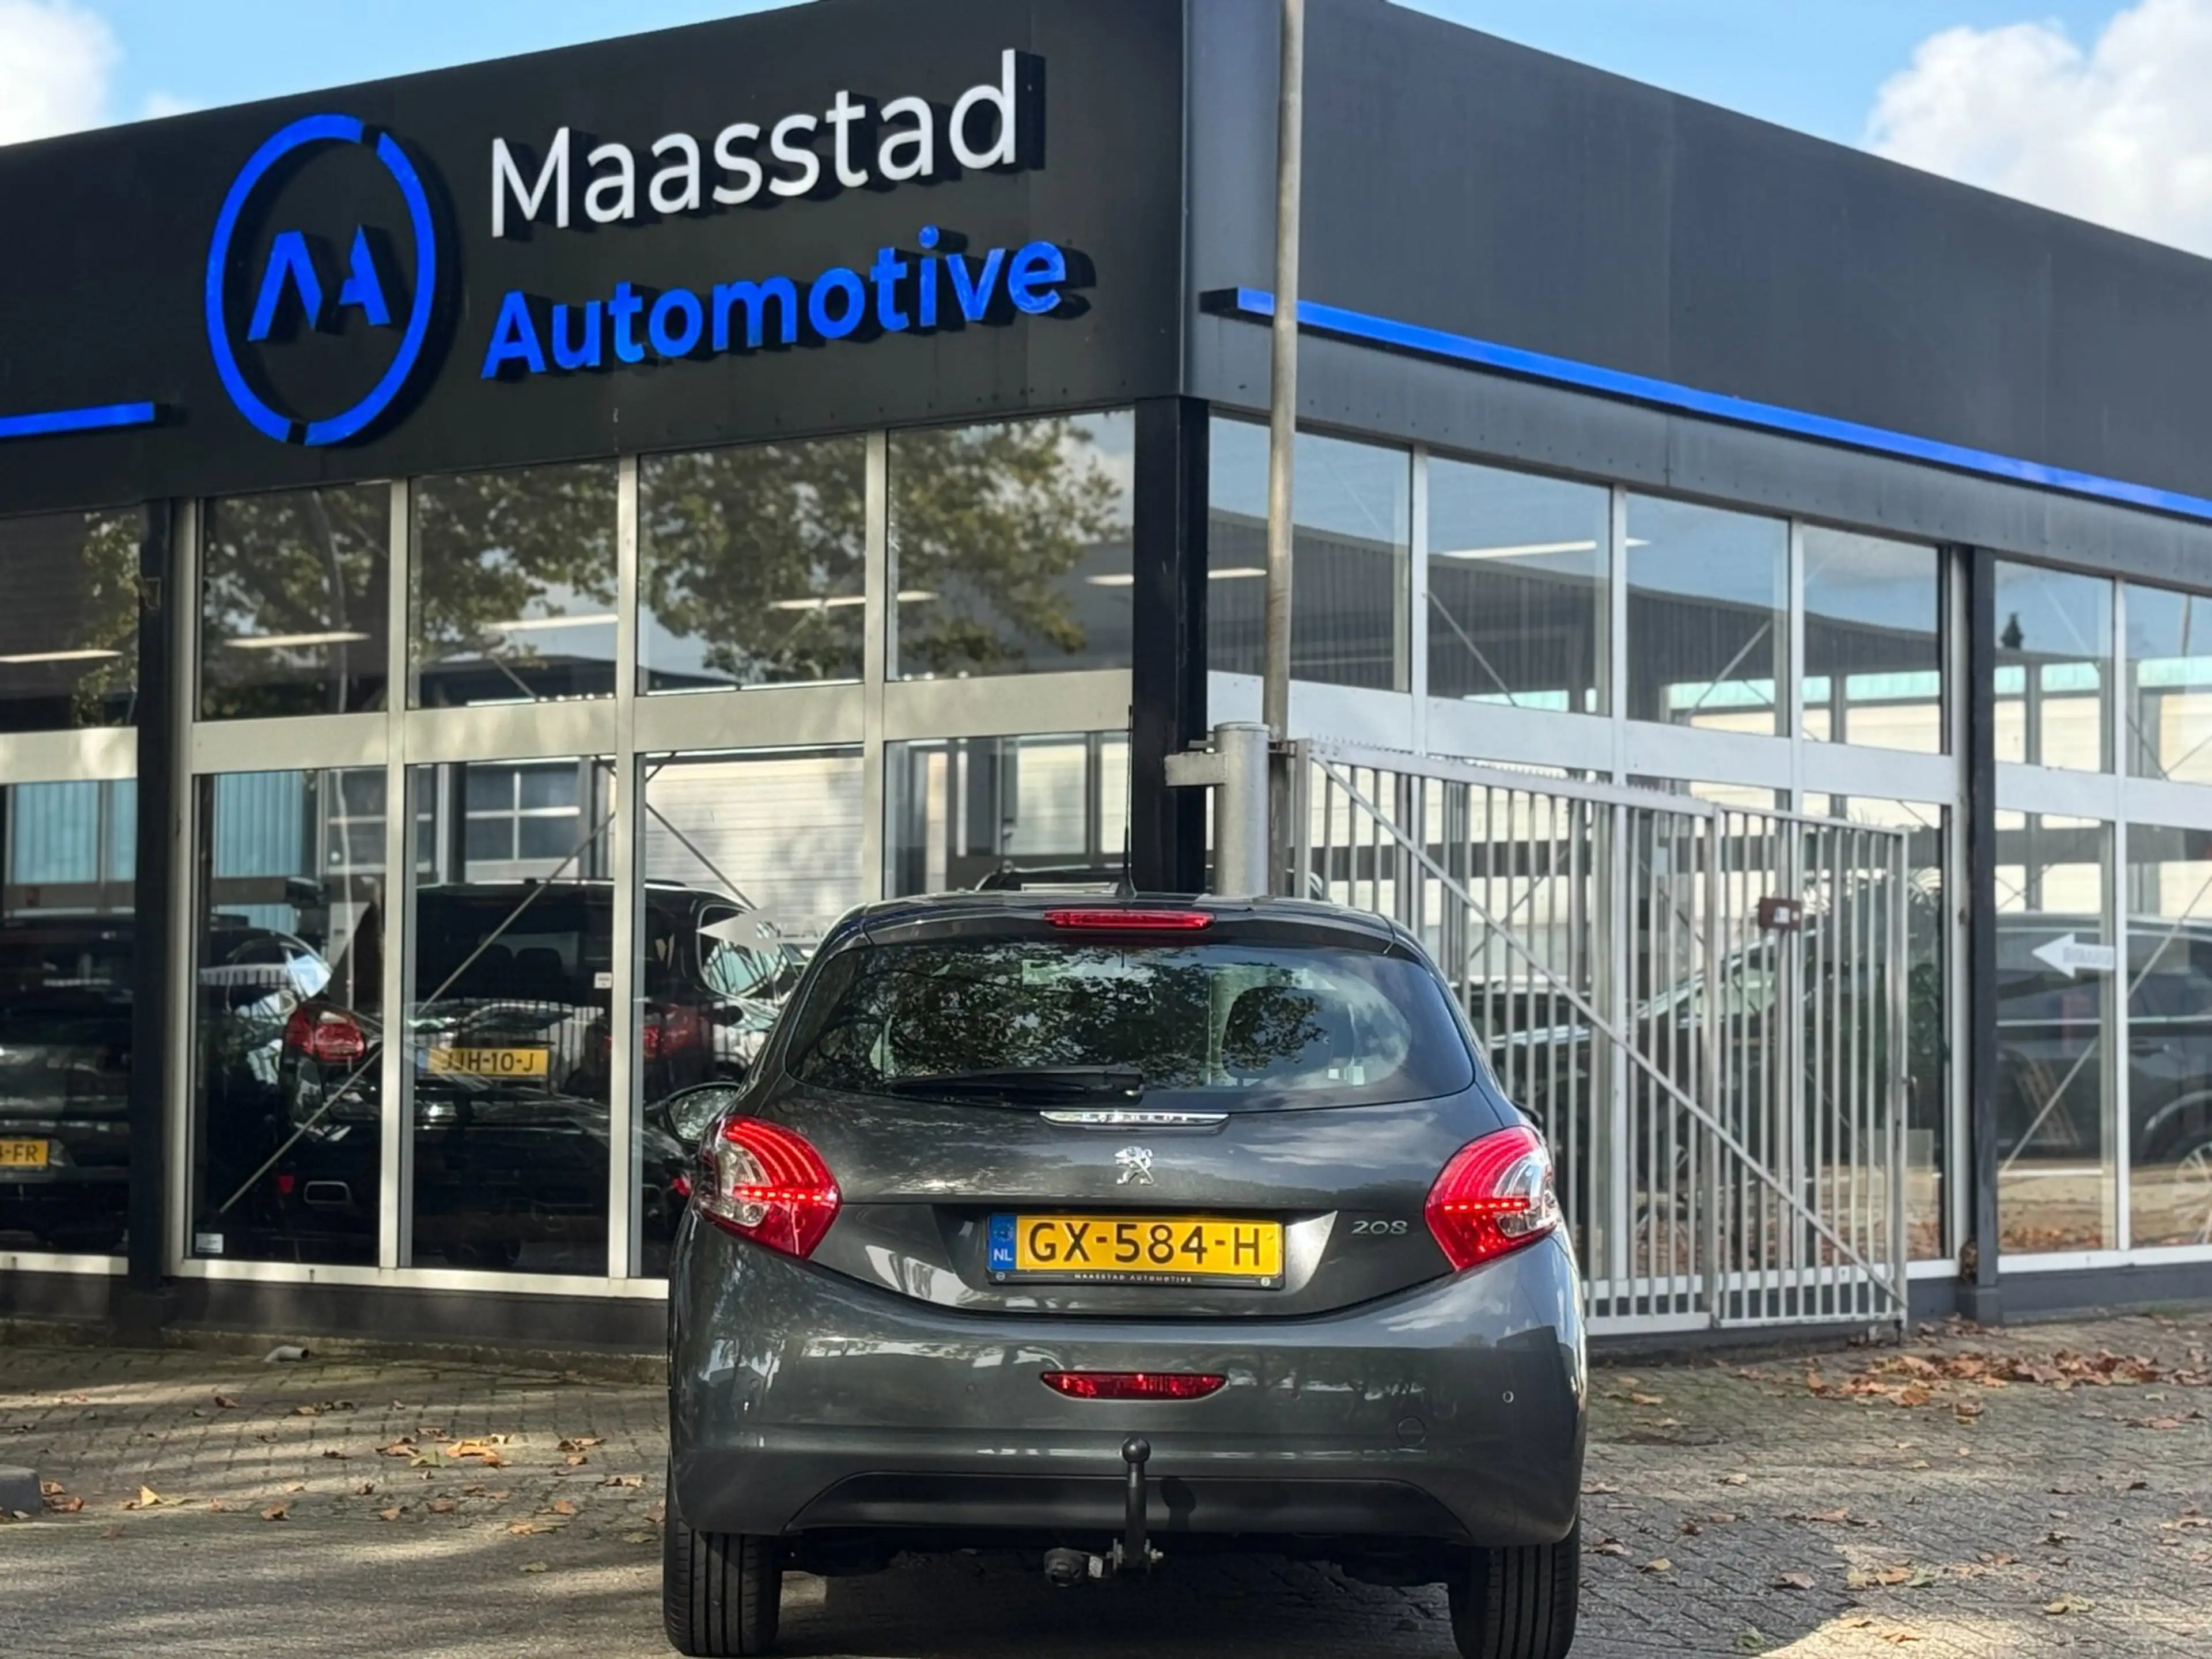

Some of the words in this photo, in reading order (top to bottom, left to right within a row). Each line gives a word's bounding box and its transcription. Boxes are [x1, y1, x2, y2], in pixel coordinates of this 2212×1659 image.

[493, 49, 1015, 237] Maasstad
[482, 225, 1066, 380] Automotive
[1029, 1222, 1260, 1266] GX-584-H
[1351, 1220, 1407, 1234] 208
[993, 1248, 1013, 1261] NL
